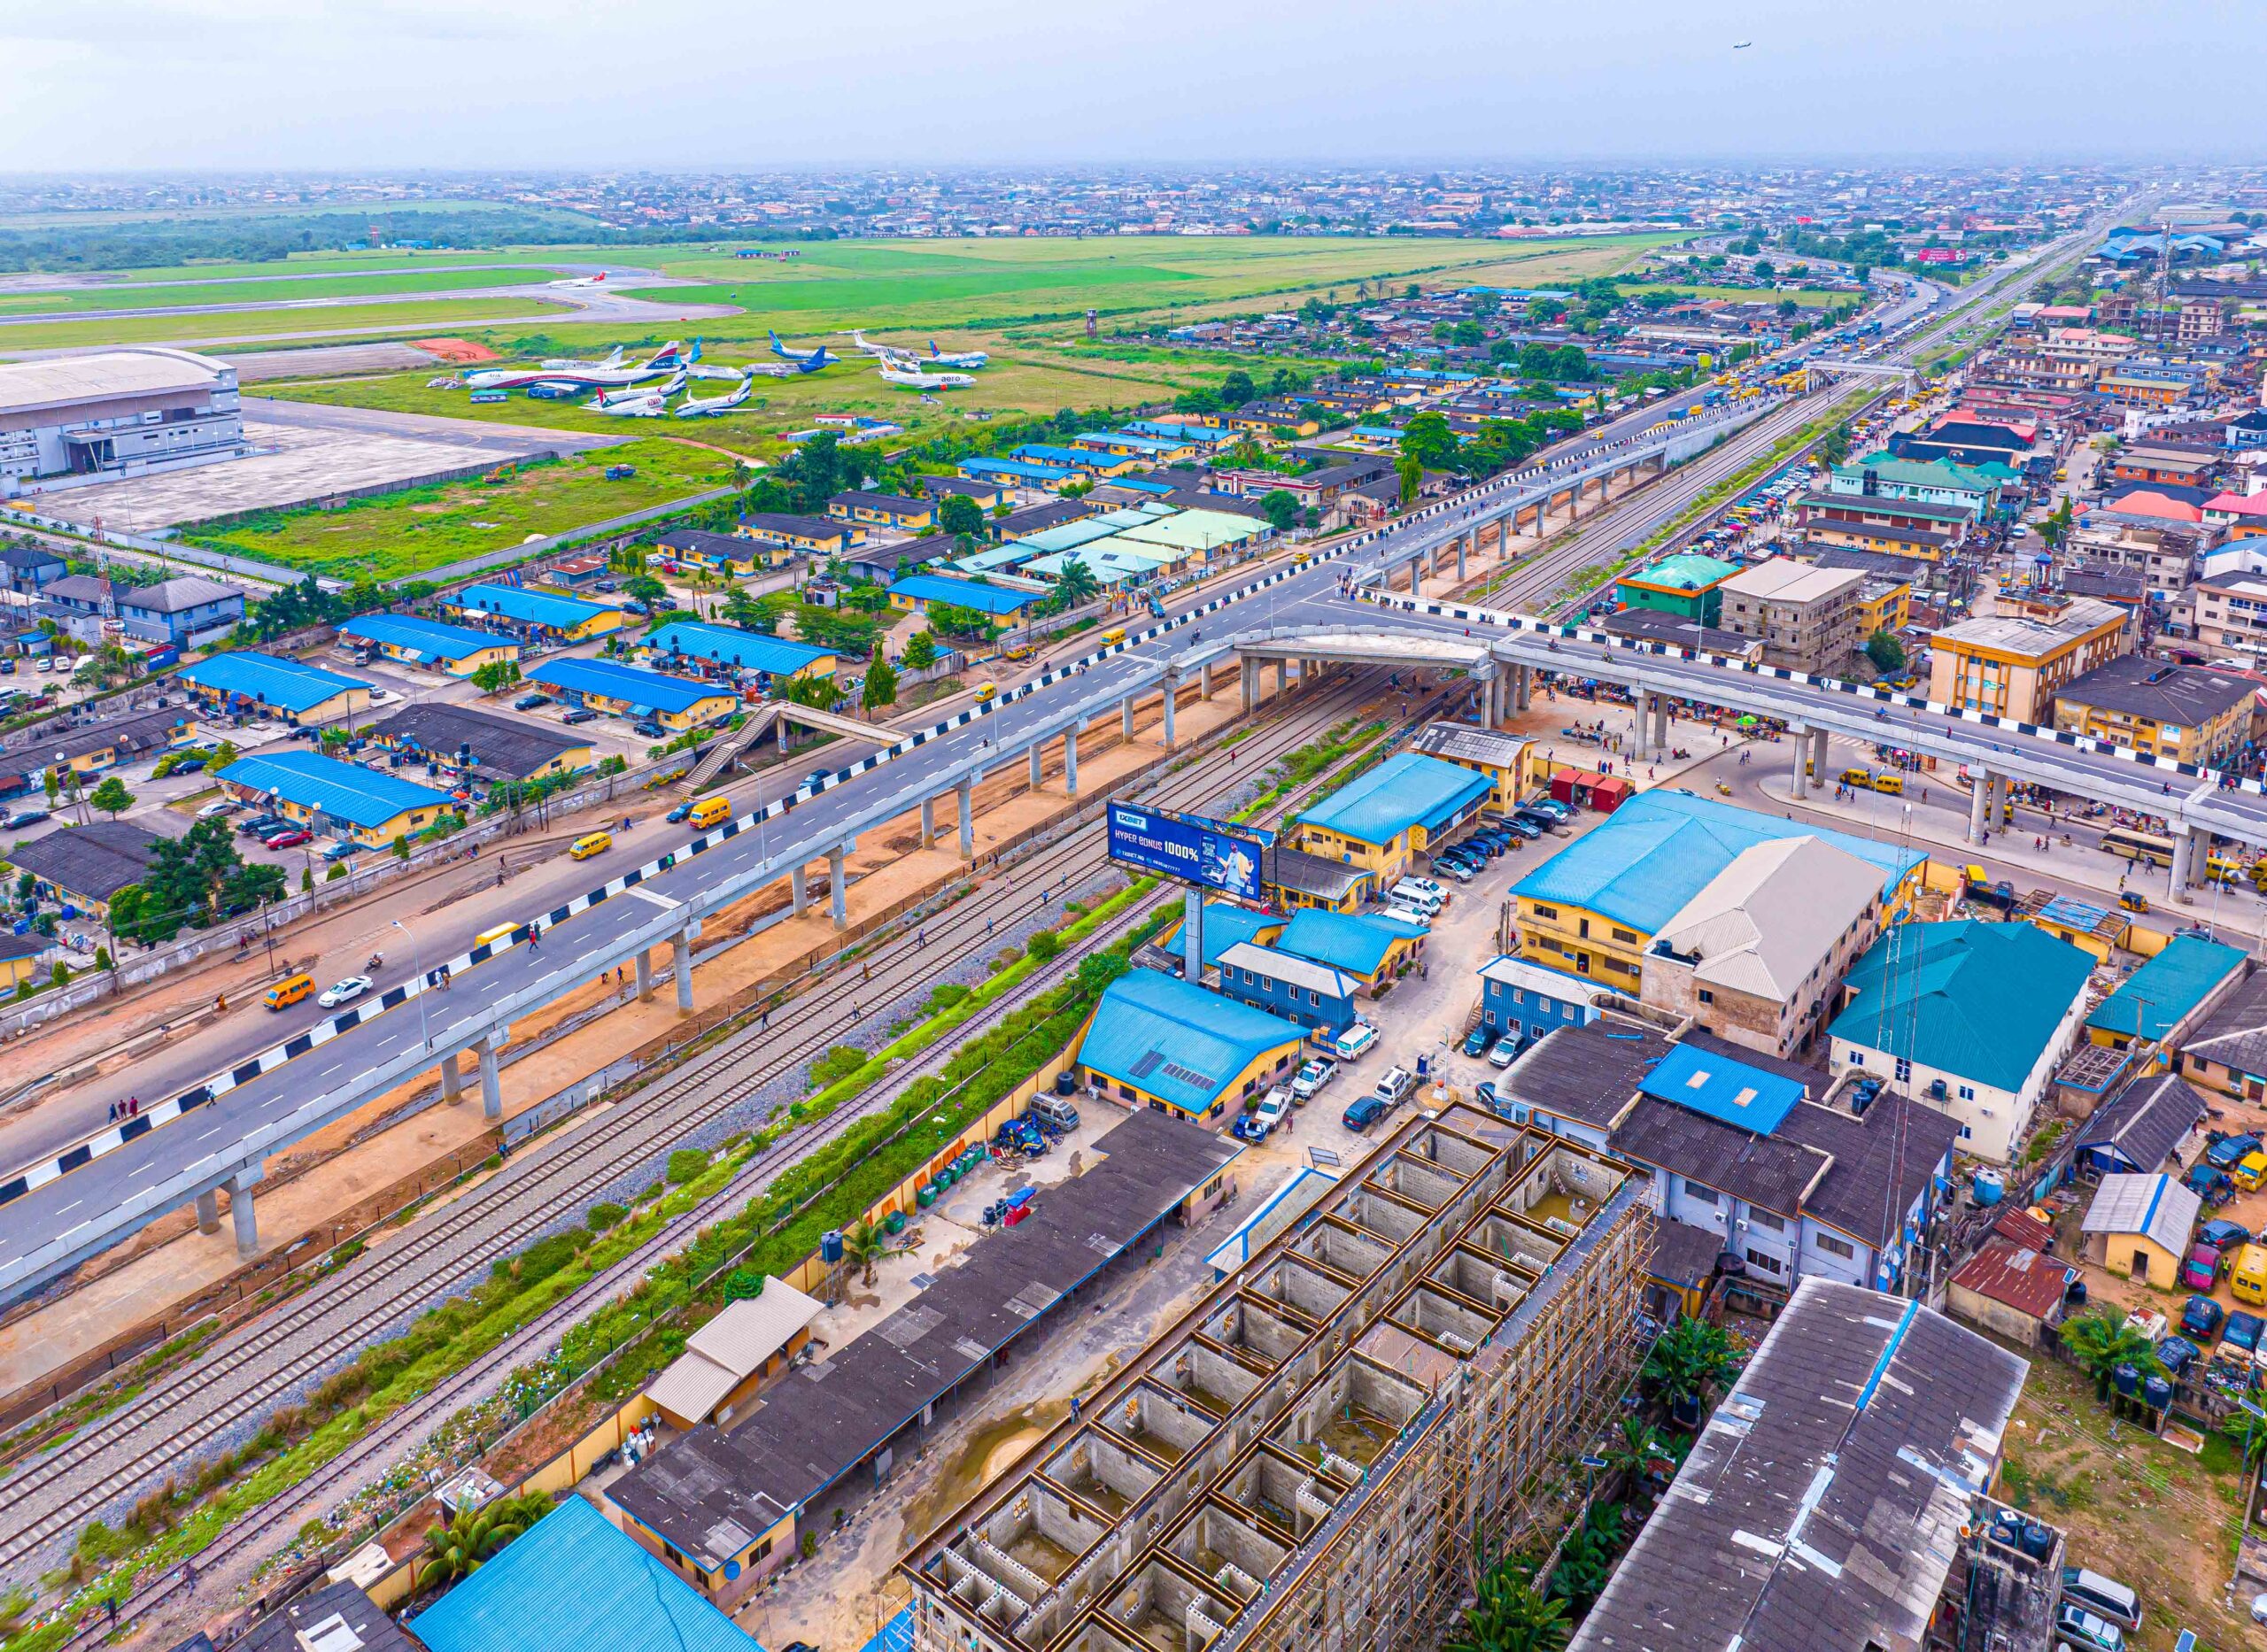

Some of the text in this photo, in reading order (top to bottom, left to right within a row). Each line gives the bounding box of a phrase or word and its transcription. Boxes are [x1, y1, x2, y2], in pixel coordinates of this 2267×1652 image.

[647, 398, 662, 406] AZMAN
[1119, 814, 1143, 825] 1XBET
[1115, 830, 1137, 844] HYPER
[1139, 837, 1163, 852] BONUS
[1164, 841, 1199, 861] 1000%
